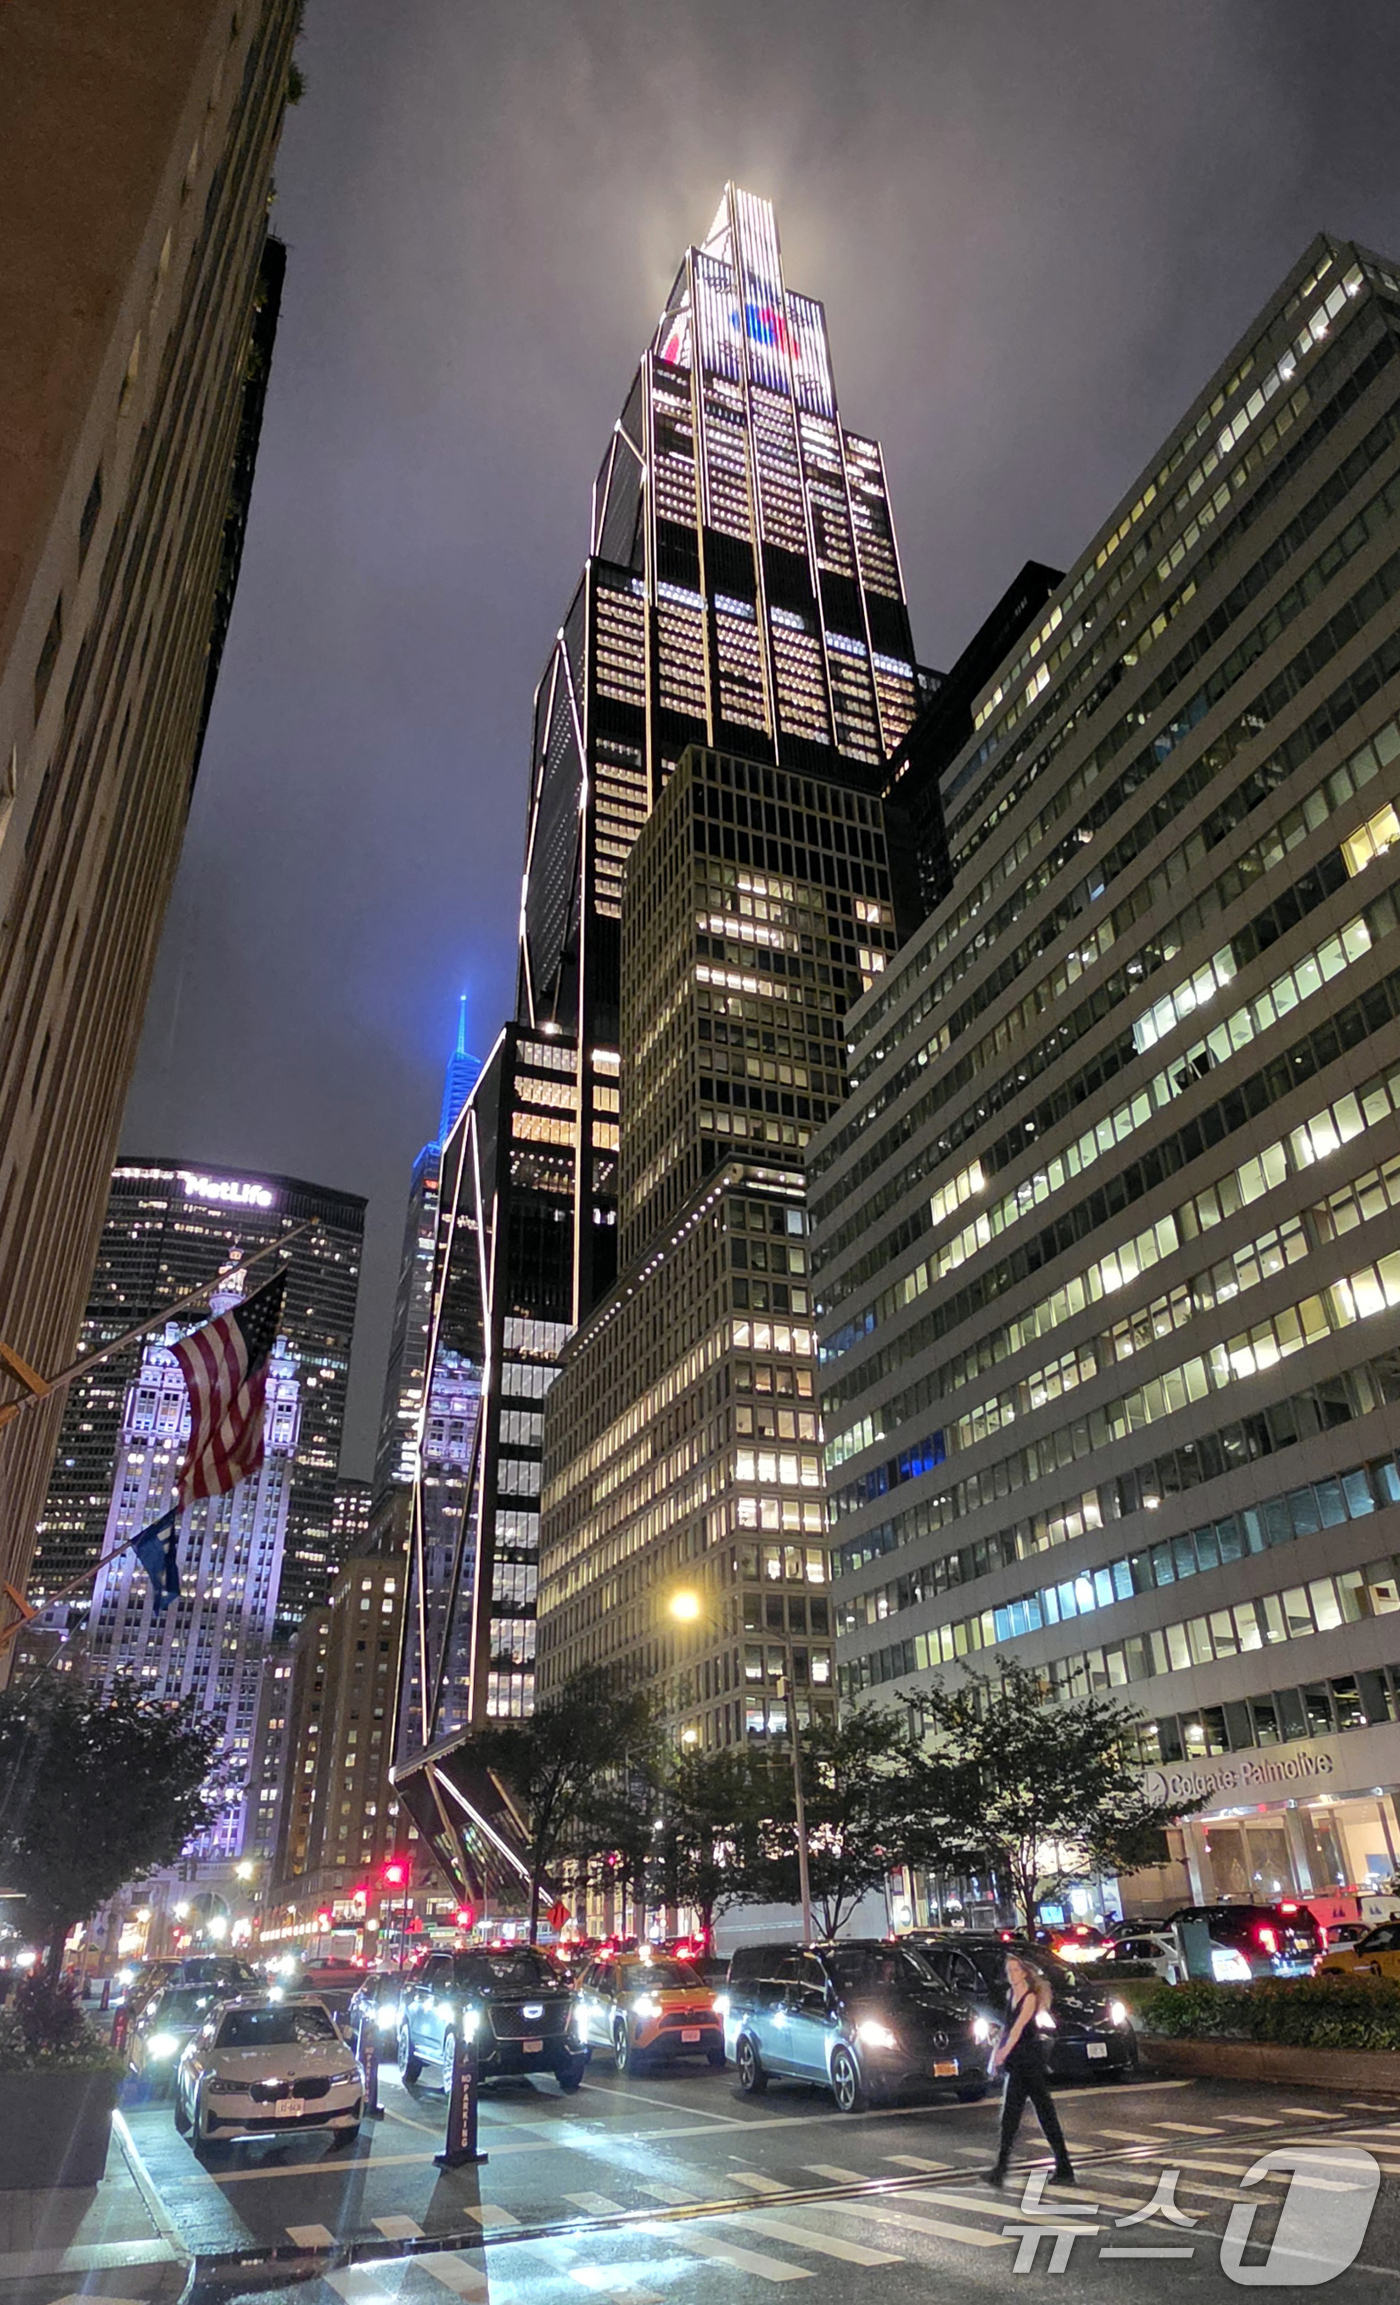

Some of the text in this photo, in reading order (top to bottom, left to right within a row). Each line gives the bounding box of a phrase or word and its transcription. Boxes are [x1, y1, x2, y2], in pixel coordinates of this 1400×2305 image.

[185, 1176, 272, 1206] MetLife
[1169, 1752, 1333, 1797] Colgate-Palmolive
[461, 2074, 472, 2083] NO
[461, 2084, 469, 2147] PARKING
